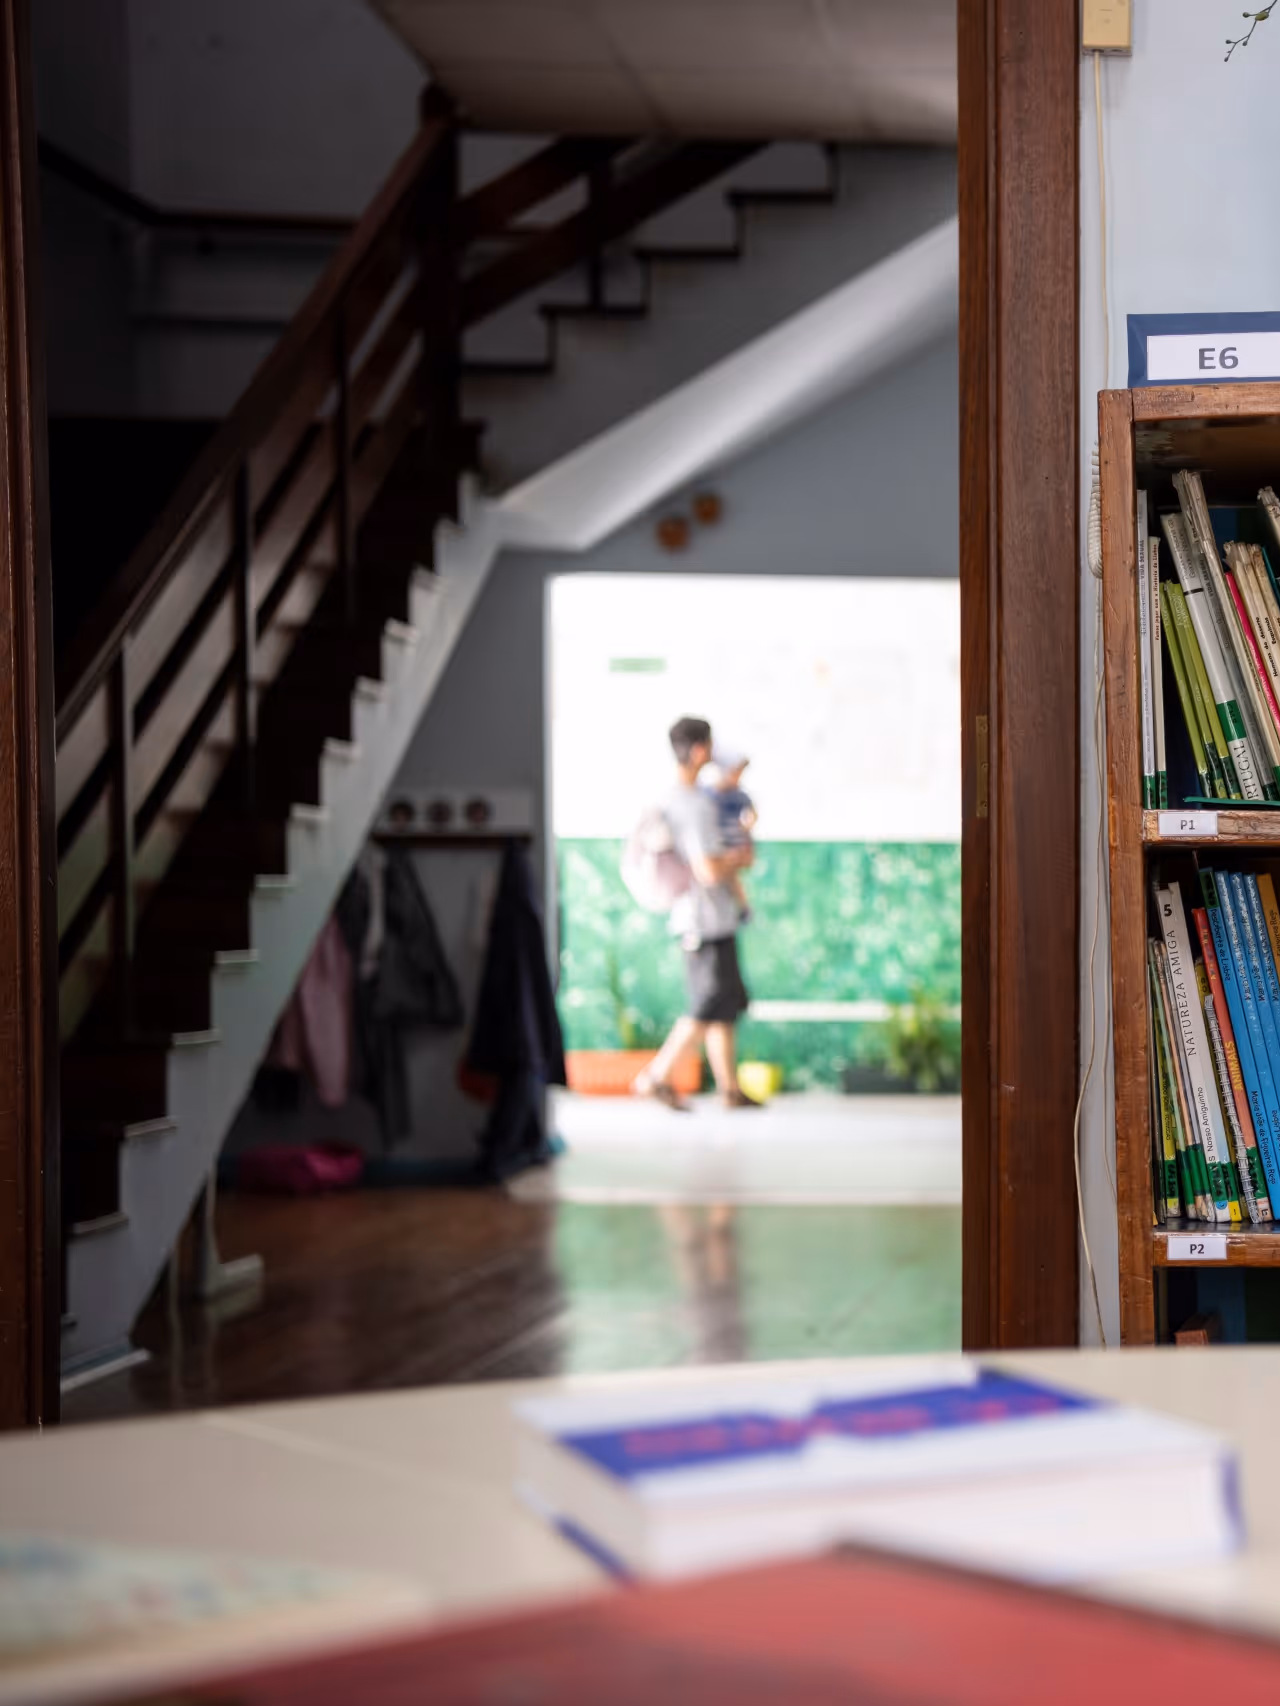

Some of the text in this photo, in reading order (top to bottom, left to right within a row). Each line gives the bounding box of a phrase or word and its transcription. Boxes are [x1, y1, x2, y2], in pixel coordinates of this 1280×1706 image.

[1198, 346, 1239, 370] E6
[1179, 819, 1195, 831] P1
[1165, 929, 1197, 1056] NATUREZA AMIGA
[1189, 1243, 1205, 1255] P2
